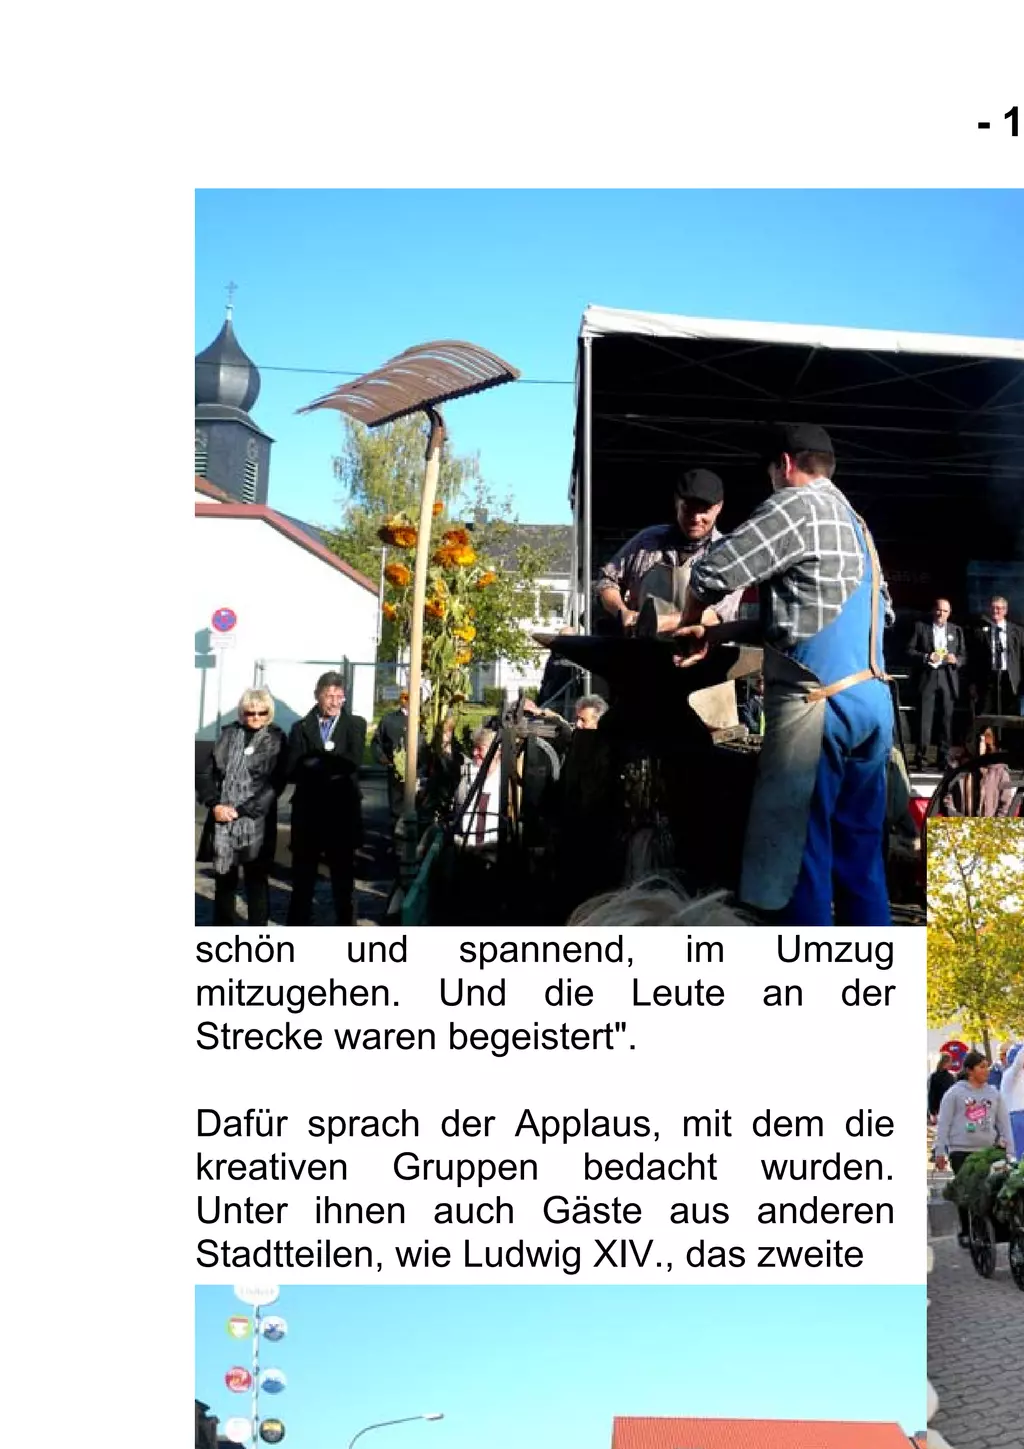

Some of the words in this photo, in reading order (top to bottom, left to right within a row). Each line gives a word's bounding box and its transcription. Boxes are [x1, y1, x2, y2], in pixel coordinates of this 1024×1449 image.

[977, 121, 991, 130] -
[195, 934, 295, 963] schön
[347, 934, 407, 963] und
[459, 934, 633, 971] spannend,
[687, 934, 724, 963] im
[777, 934, 894, 971] Umzug
[197, 977, 399, 1015] mitzugehen.
[440, 977, 506, 1007] Und
[544, 977, 594, 1007] die
[633, 977, 725, 1007] Leute
[763, 984, 803, 1007] an
[841, 977, 897, 1007] der
[196, 1020, 323, 1051] Strecke
[333, 1028, 436, 1051] waren
[449, 1021, 636, 1058] begeistert".
[197, 1108, 289, 1138] Dafür
[308, 1108, 419, 1145] sprach
[441, 1108, 497, 1138] der
[514, 1108, 660, 1145] Applaus,
[683, 1108, 733, 1138] mit
[752, 1108, 824, 1138] dem
[845, 1108, 895, 1138] die
[197, 1151, 347, 1181] kreativen
[393, 1151, 538, 1188] Gruppen
[584, 1151, 718, 1181] bedacht
[760, 1151, 893, 1181] wurden.
[196, 1238, 382, 1273] Stadtteilen,
[394, 1239, 451, 1268] wie
[464, 1239, 581, 1276] Ludwig
[593, 1239, 673, 1273] XIV.,
[686, 1239, 746, 1268] das
[757, 1239, 864, 1268] zweite
